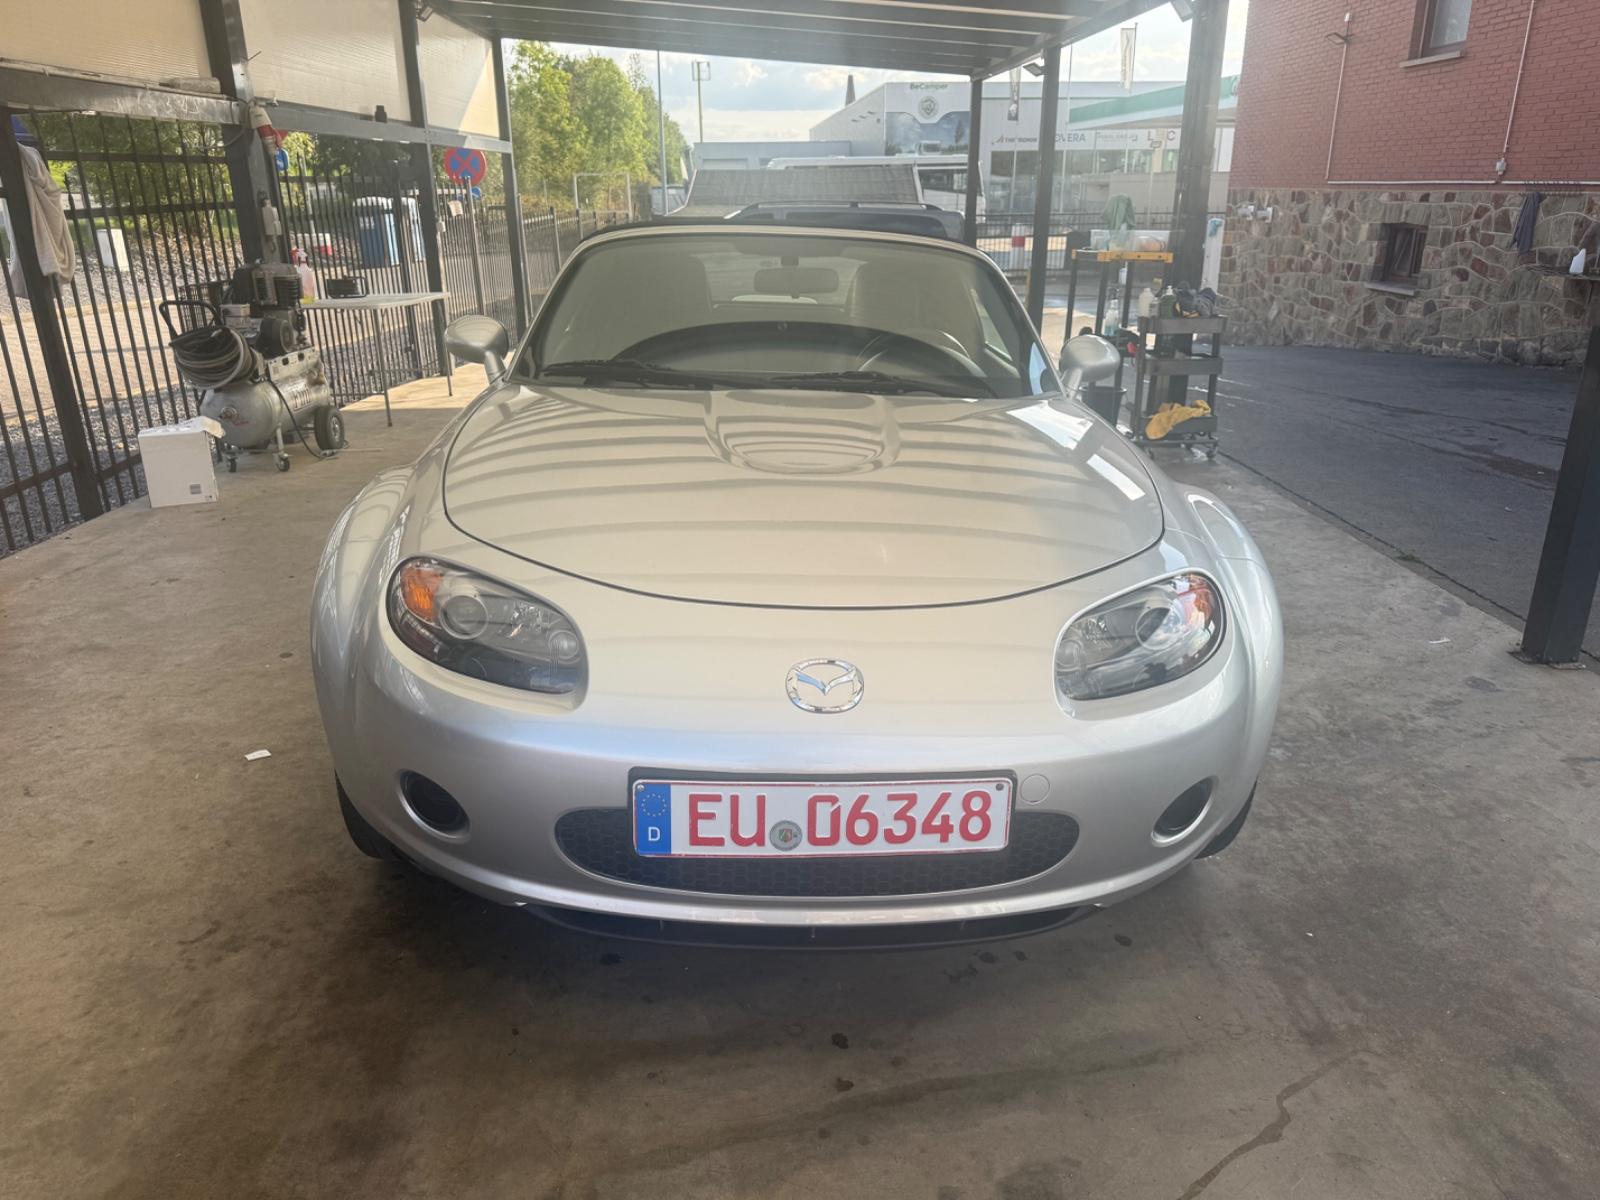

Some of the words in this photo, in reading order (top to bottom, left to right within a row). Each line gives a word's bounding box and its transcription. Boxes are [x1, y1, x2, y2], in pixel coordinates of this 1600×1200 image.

[1055, 132, 1086, 143] OVERA
[1147, 130, 1176, 141] LC
[688, 793, 766, 848] EU
[807, 790, 992, 846] 06348
[647, 826, 661, 842] D
